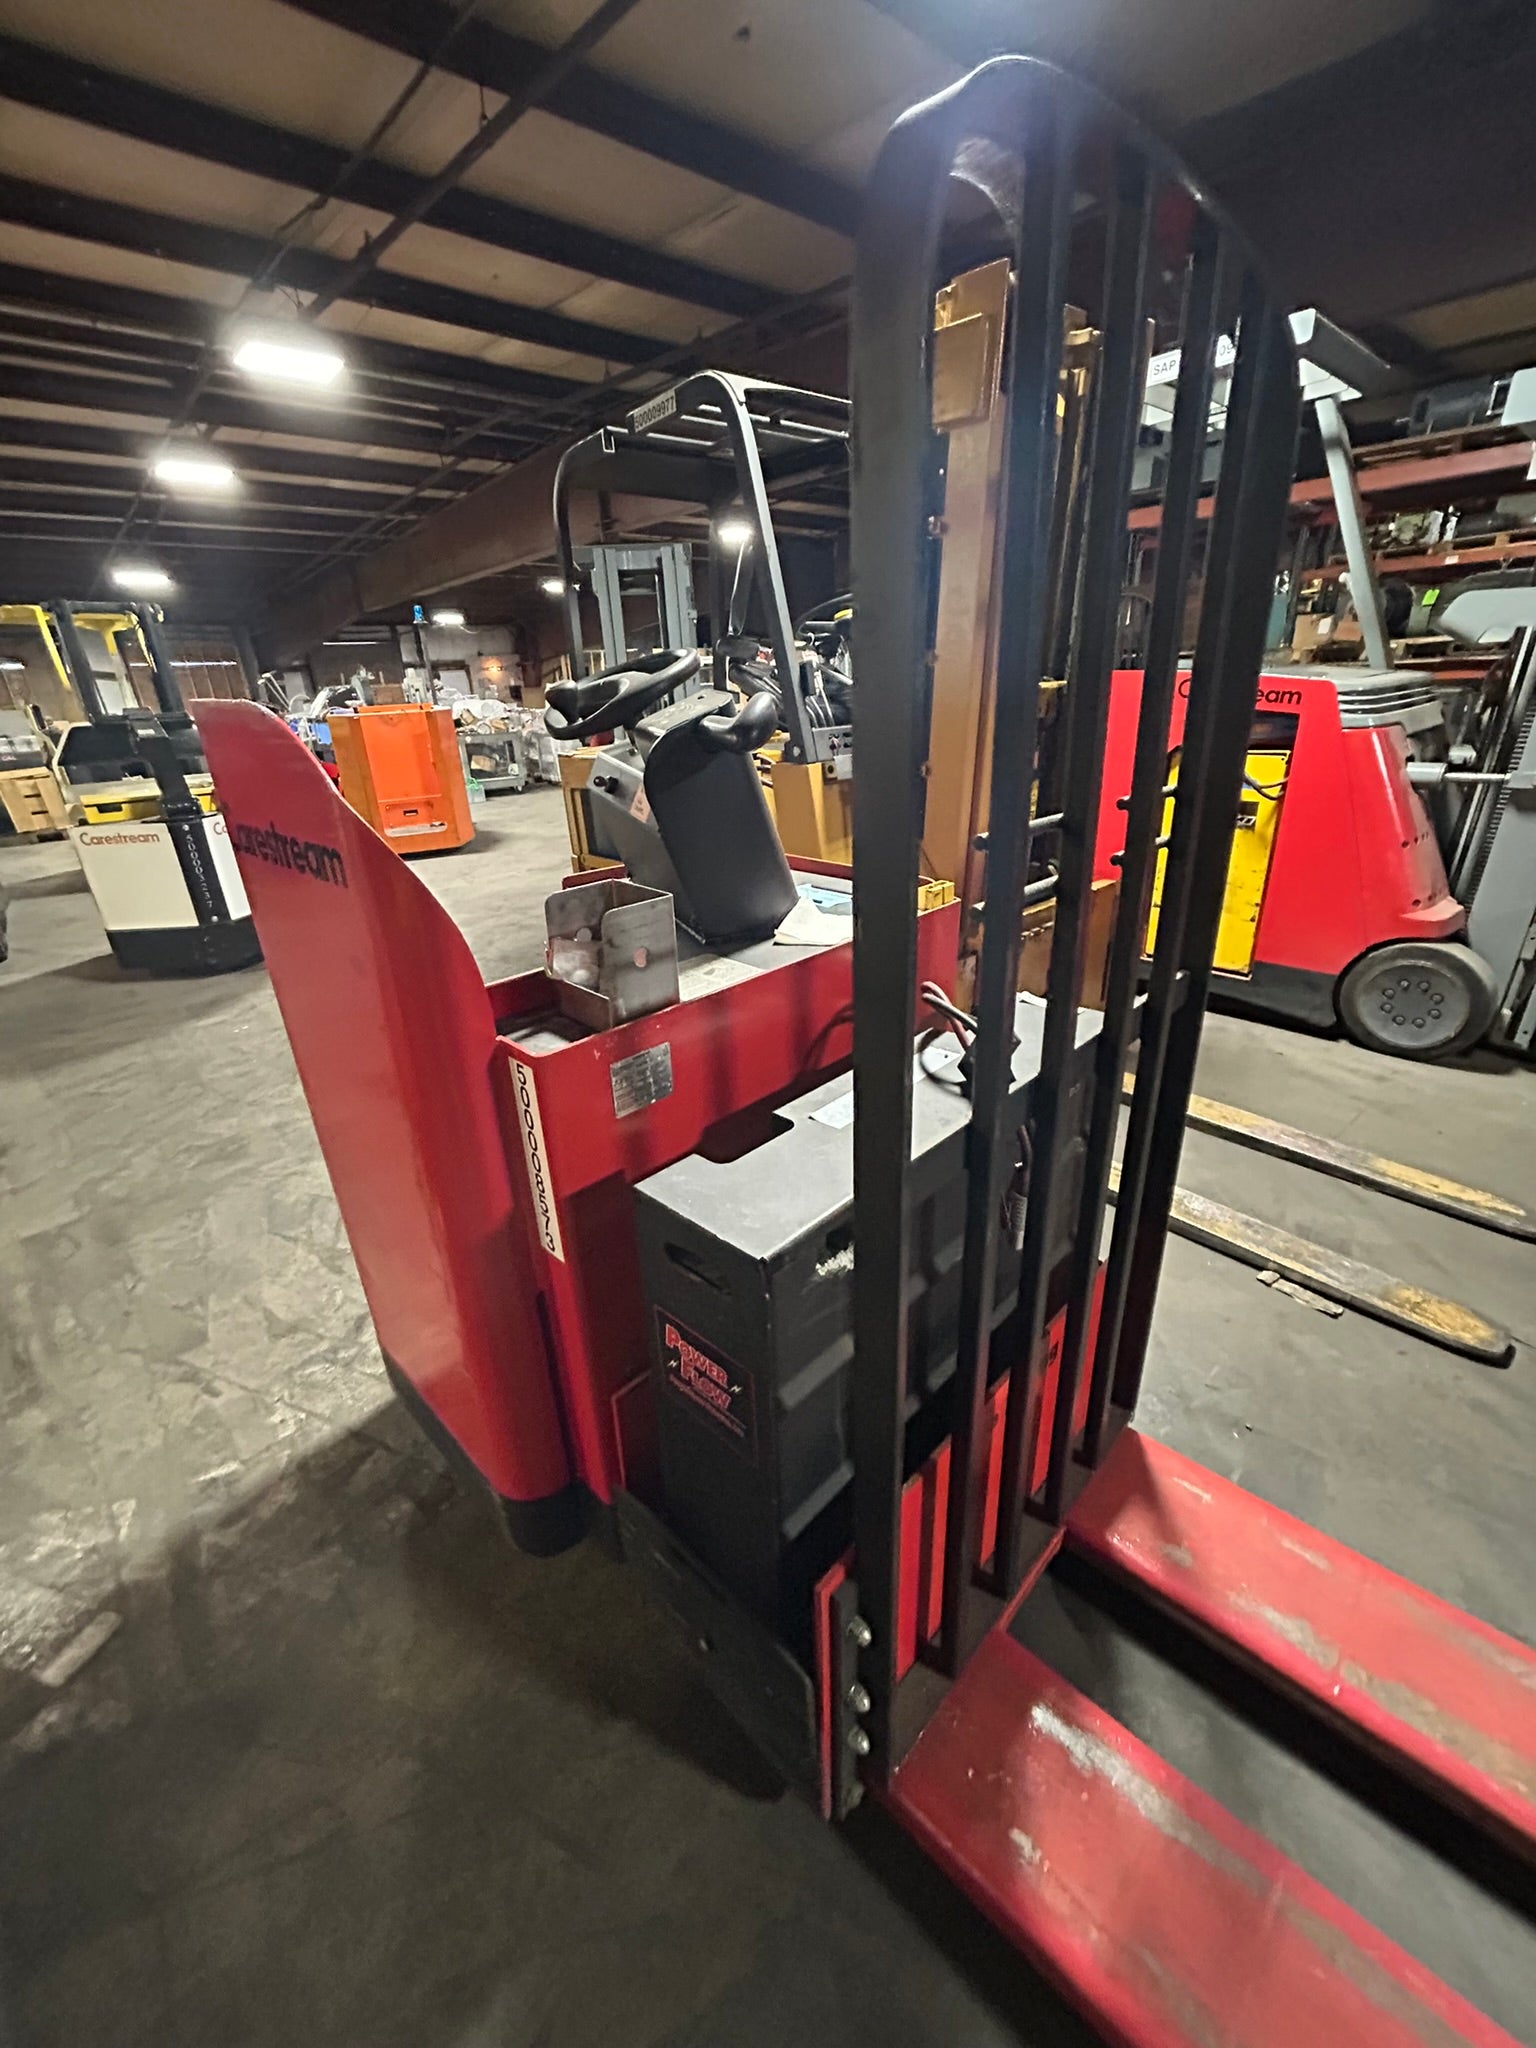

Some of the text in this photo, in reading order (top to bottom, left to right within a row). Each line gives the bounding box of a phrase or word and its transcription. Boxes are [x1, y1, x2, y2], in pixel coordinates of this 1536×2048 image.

[1153, 359, 1177, 376] SAP
[79, 831, 161, 847] Carestream
[516, 1063, 556, 1252] 500008573
